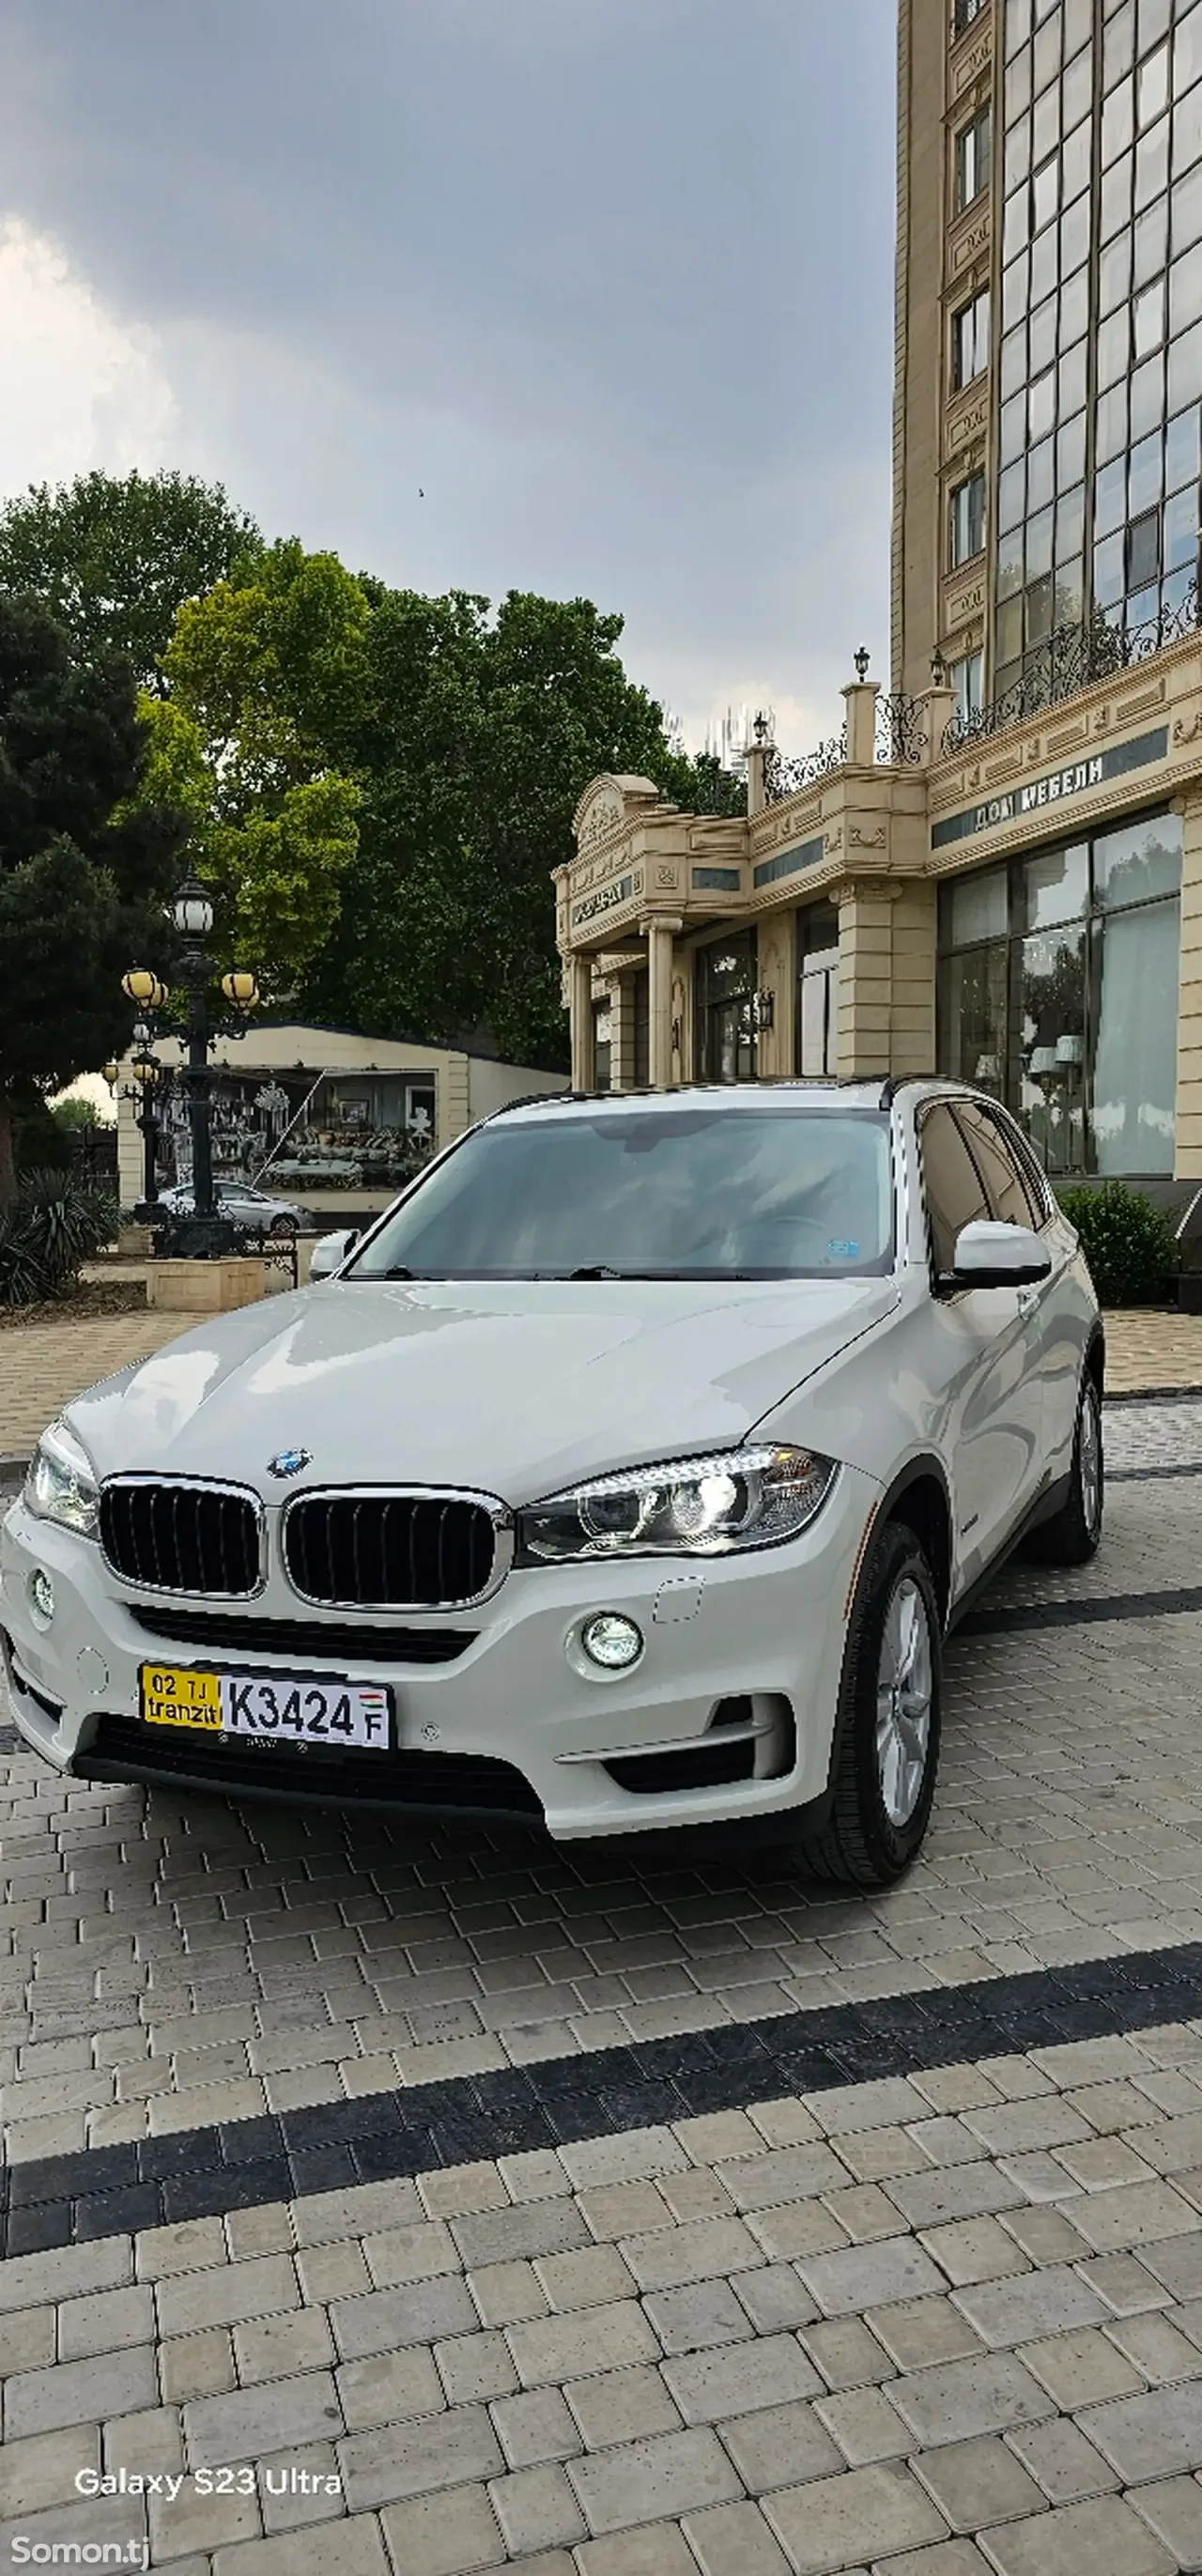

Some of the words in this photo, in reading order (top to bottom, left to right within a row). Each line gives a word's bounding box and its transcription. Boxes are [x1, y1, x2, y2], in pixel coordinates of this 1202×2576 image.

[975, 795, 1015, 831] ДОМ
[1021, 757, 1103, 810] МЕБЕЛИ
[152, 1674, 177, 1695] 02
[188, 1681, 207, 1701] TJ
[148, 1698, 218, 1725] tranzit
[229, 1683, 355, 1736] K3424
[365, 1713, 382, 1740] F
